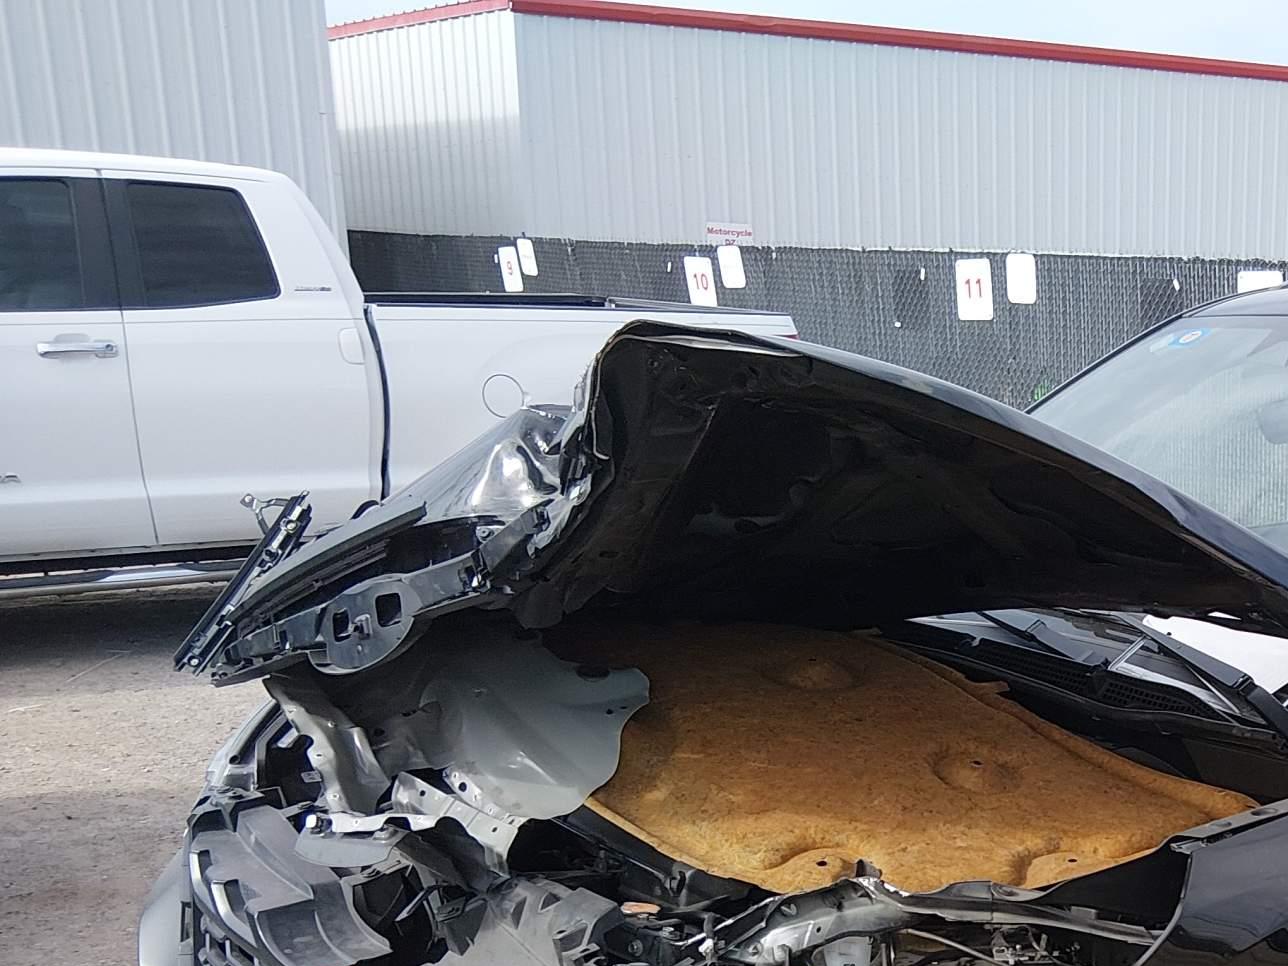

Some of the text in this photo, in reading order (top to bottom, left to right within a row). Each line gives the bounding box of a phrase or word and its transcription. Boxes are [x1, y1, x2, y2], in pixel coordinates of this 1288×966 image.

[706, 226, 753, 238] Motorcycle
[506, 260, 514, 276] 9
[693, 273, 709, 291] 10
[964, 278, 983, 299] 11
